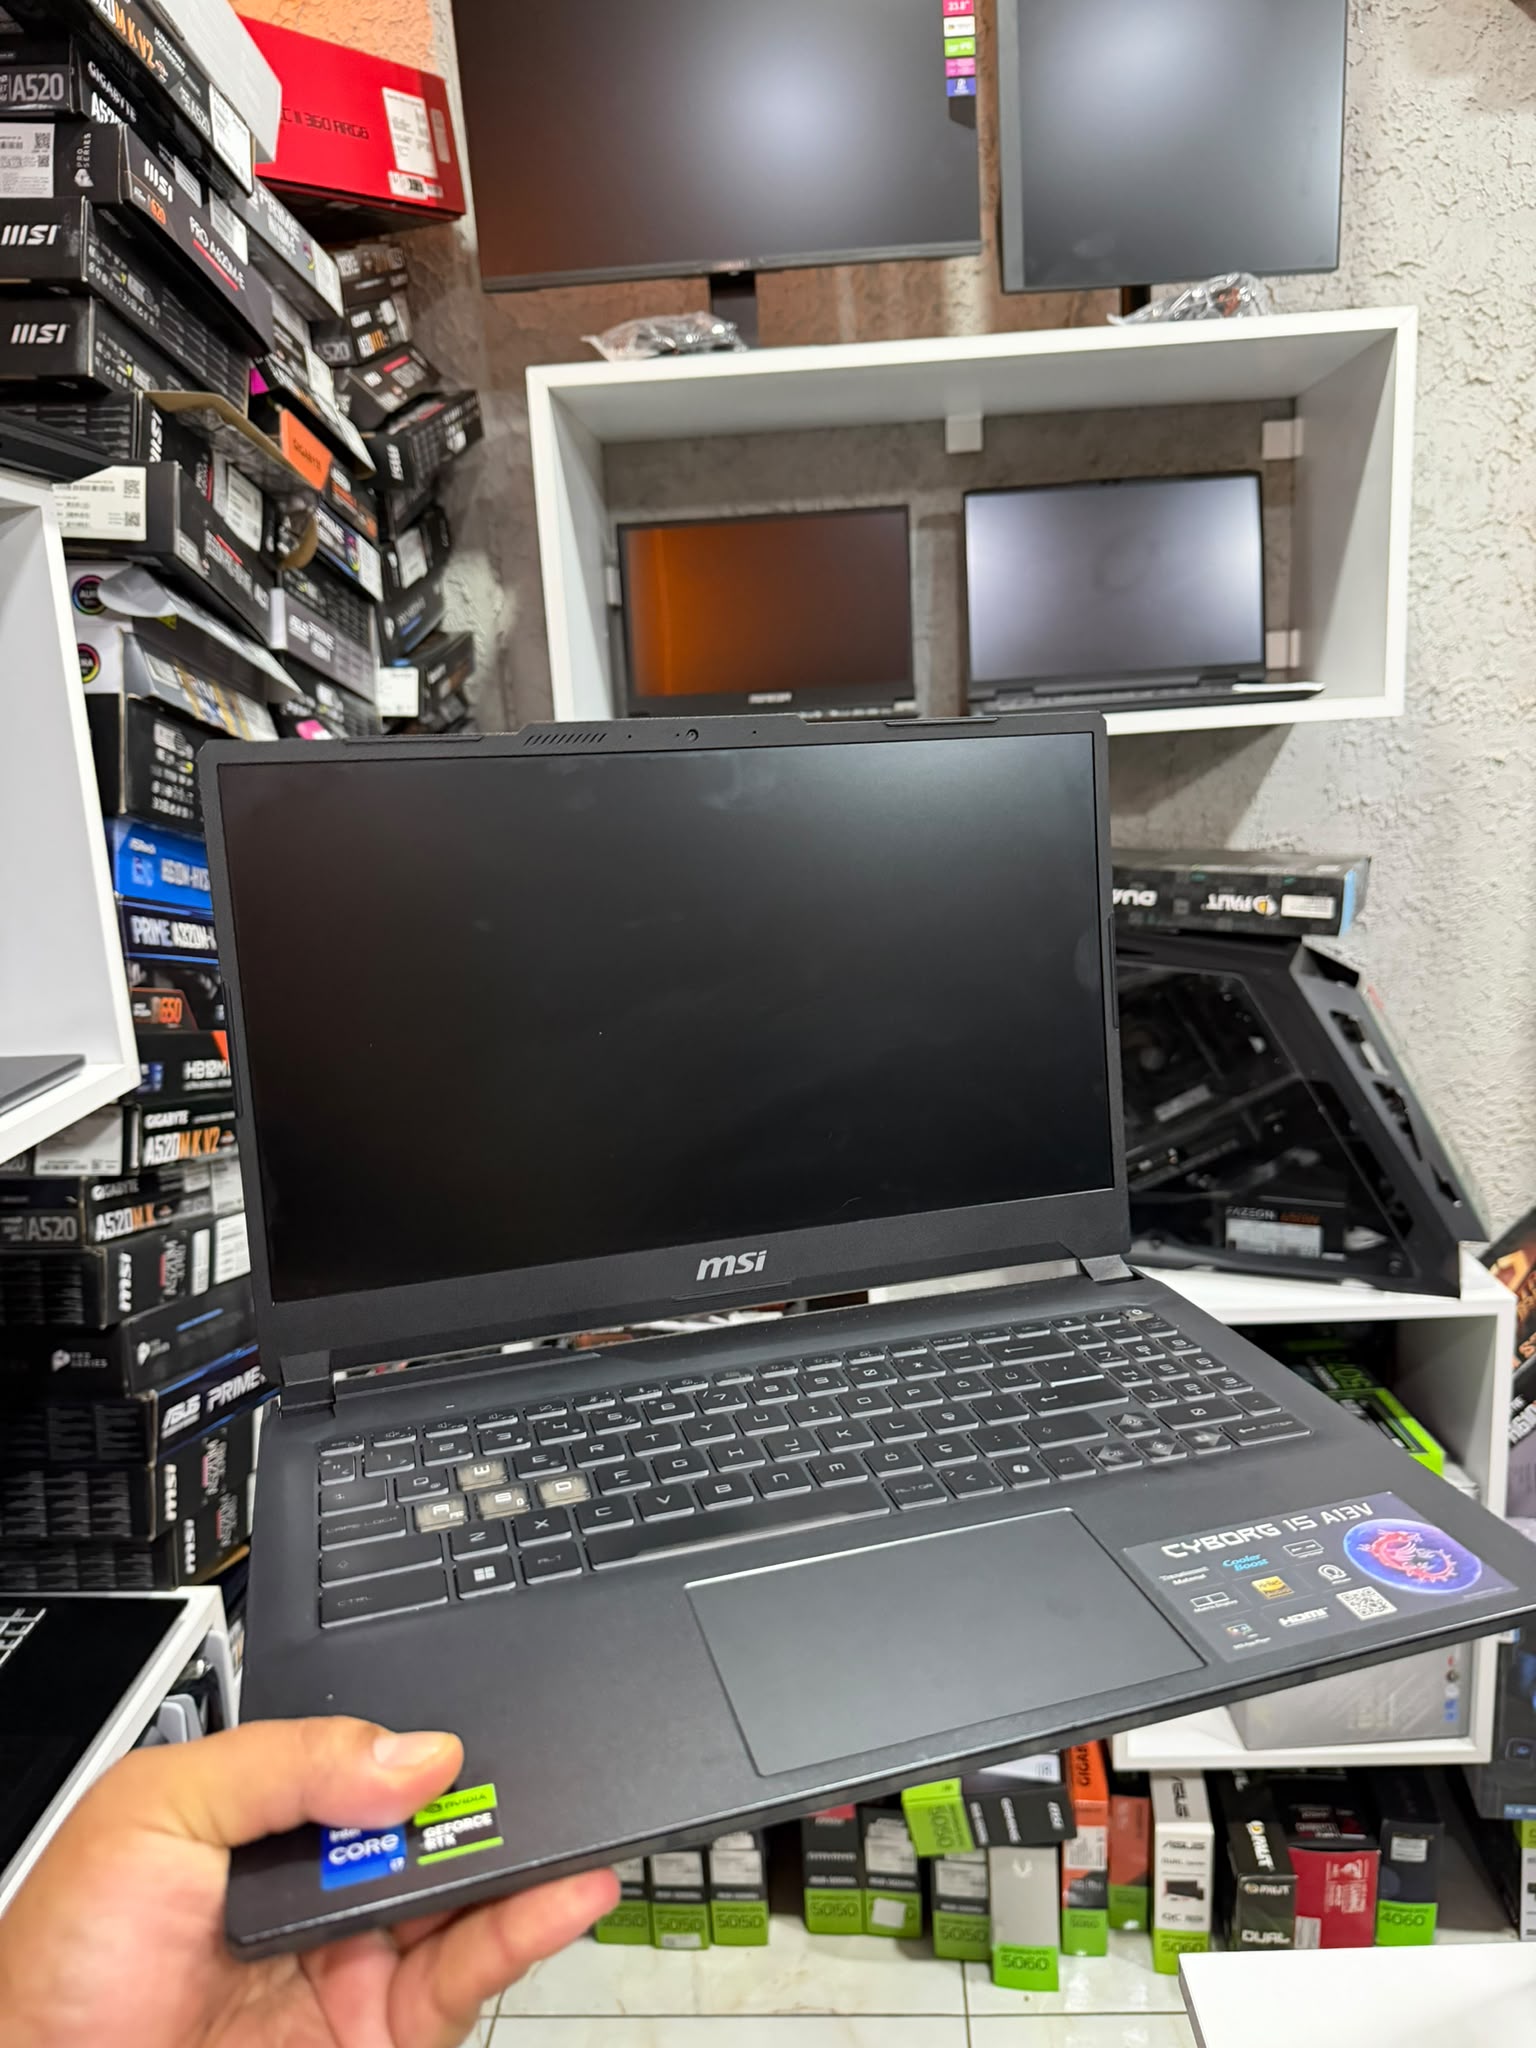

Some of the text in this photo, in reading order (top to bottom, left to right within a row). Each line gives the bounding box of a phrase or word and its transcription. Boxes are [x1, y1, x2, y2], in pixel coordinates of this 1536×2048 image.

[12, 73, 64, 102] A520
[88, 61, 137, 123] GIGABYTE
[304, 113, 332, 131] 360
[333, 121, 370, 140] ARGB
[76, 148, 84, 168] PRO
[83, 133, 92, 168] SERIES
[144, 158, 174, 203] MSI
[1, 224, 57, 246] MSI
[10, 323, 67, 344] MSI
[130, 915, 173, 947] PRIME
[144, 1110, 190, 1129] GIGABYTE
[143, 1132, 190, 1167] A520M
[203, 1126, 221, 1154] V2
[27, 1216, 78, 1241] A520
[95, 1207, 146, 1242] A520M
[696, 1250, 767, 1281] msi
[206, 1365, 261, 1413] PRIME
[906, 1388, 921, 1397] P
[753, 1413, 769, 1422] U
[889, 1421, 905, 1429] L
[700, 1423, 713, 1431] Y
[836, 1429, 852, 1438] K
[645, 1433, 660, 1442] T
[589, 1443, 605, 1453] R
[728, 1447, 745, 1458] H
[829, 1462, 846, 1472] M
[772, 1472, 790, 1482] N
[555, 1481, 572, 1493] D
[715, 1484, 732, 1494] B
[656, 1494, 671, 1504] V
[433, 1503, 450, 1516] A
[595, 1506, 613, 1517] C
[534, 1519, 550, 1529] X
[1160, 1502, 1374, 1559] CYBORG 15 A13V
[1222, 1553, 1262, 1567] Cooler
[1233, 1559, 1269, 1573] Boost
[1279, 1607, 1329, 1628] HDMI
[422, 1812, 493, 1840] GEFORCE
[328, 1834, 399, 1866] CORE
[423, 1833, 457, 1852] RTX
[1162, 1840, 1206, 1851] ASUS
[811, 1903, 858, 1919] 5050
[717, 1914, 764, 1930] 5050
[1380, 1912, 1426, 1927] 4060
[1241, 1930, 1291, 1945] DUAL
[1001, 1955, 1049, 1971] 5060
